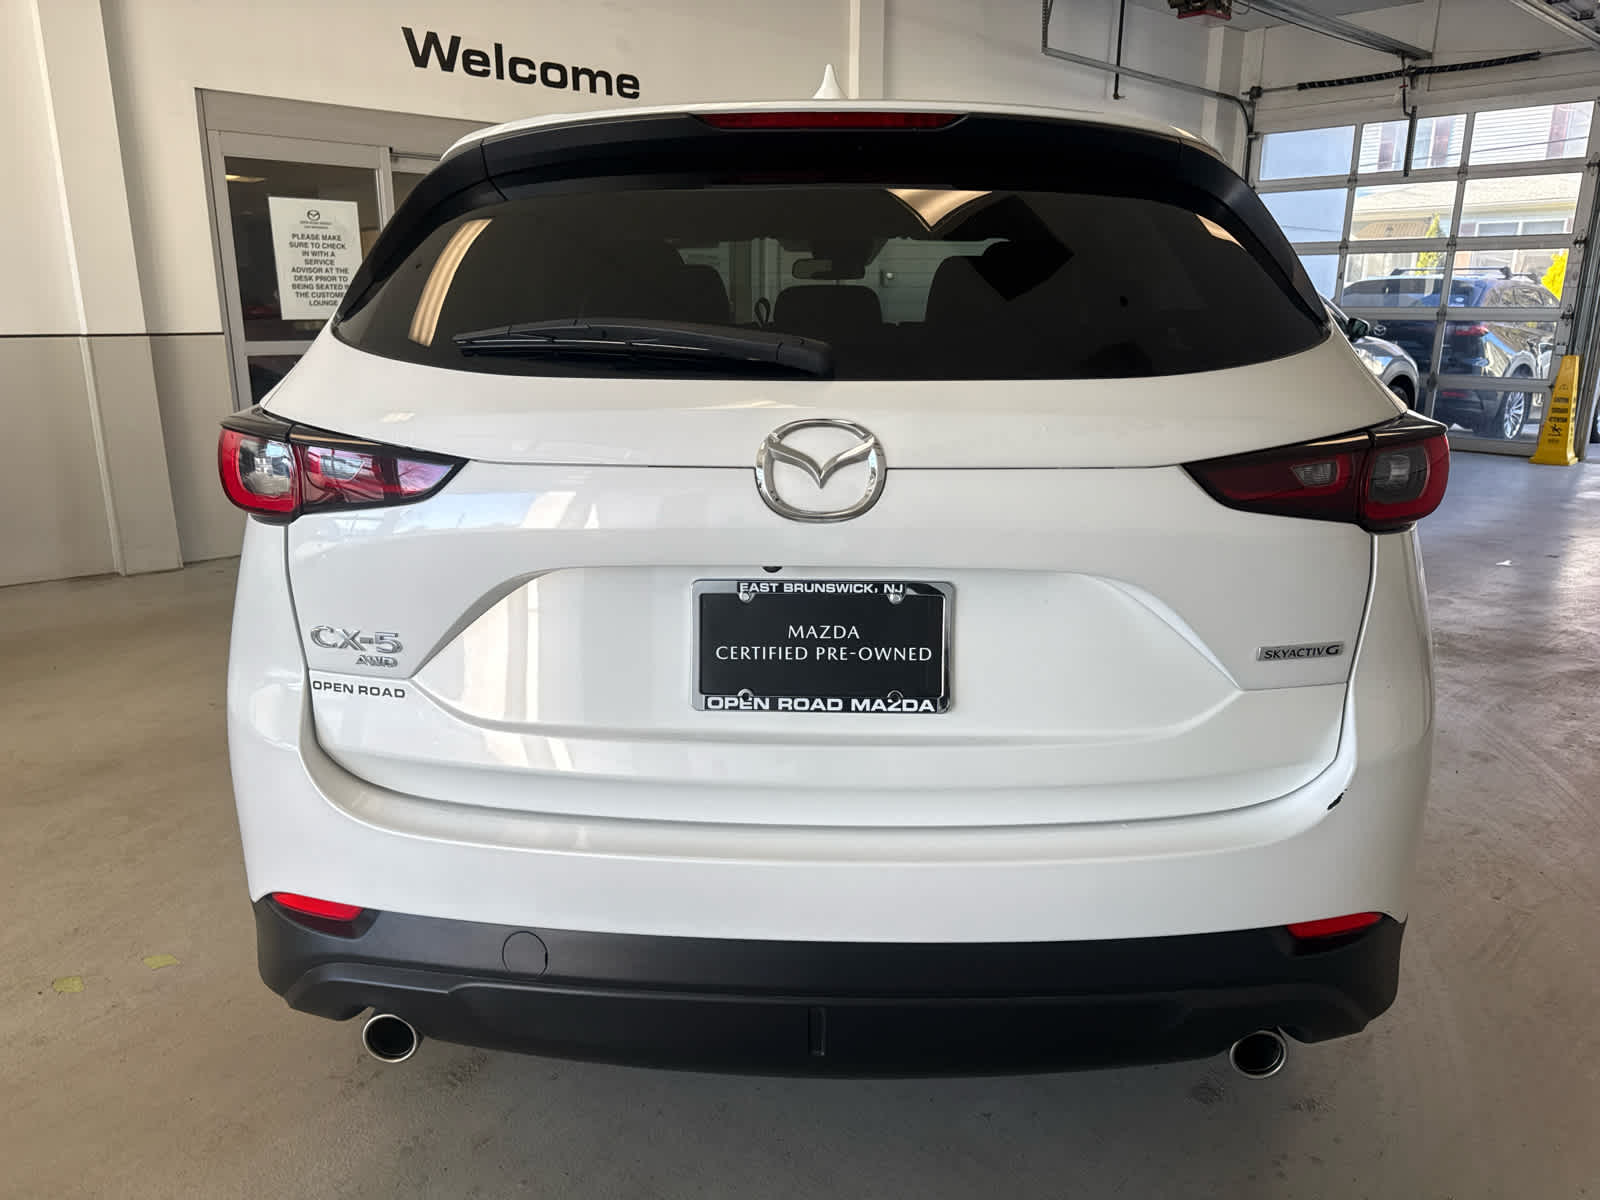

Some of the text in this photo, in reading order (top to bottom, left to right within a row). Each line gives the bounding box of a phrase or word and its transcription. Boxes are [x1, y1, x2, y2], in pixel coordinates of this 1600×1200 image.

[401, 26, 640, 100] Welcome
[739, 582, 904, 594] EAST BRUNSWICK, NJ
[310, 625, 404, 654] CX-5
[788, 625, 860, 639] MAZDA
[715, 646, 932, 661] CERTIFIED PRE-OWNED
[355, 655, 398, 668] AWD
[312, 680, 405, 698] OPEN ROAD
[707, 696, 936, 712] OPEN ROAD MAZDA
